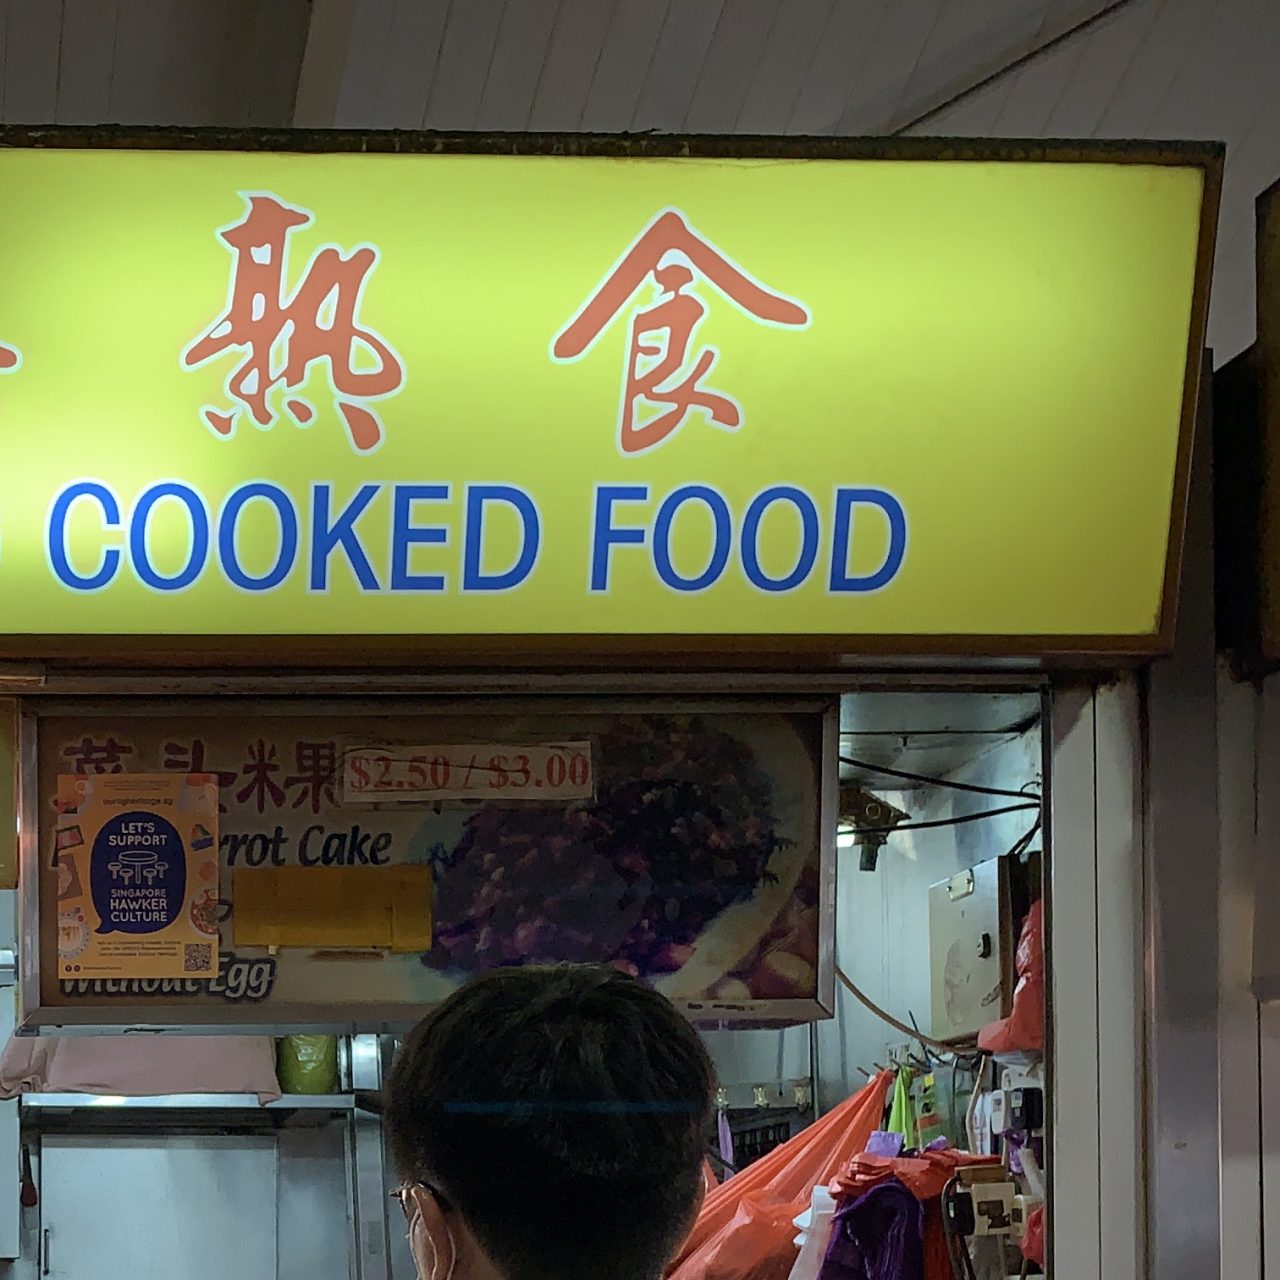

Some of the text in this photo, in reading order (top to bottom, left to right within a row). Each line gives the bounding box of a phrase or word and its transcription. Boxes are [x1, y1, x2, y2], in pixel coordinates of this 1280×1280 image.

[48, 481, 541, 592] COOKED
[592, 484, 907, 593] FOOD
[349, 754, 450, 790] $2.50
[488, 752, 589, 789] $3.00
[120, 821, 156, 834] LET'S
[108, 835, 168, 847] SUPPORT
[298, 825, 393, 867] Cake
[110, 888, 168, 898] SINGAPORE
[110, 898, 168, 910] HAWKER
[110, 911, 168, 923] CULTURE
